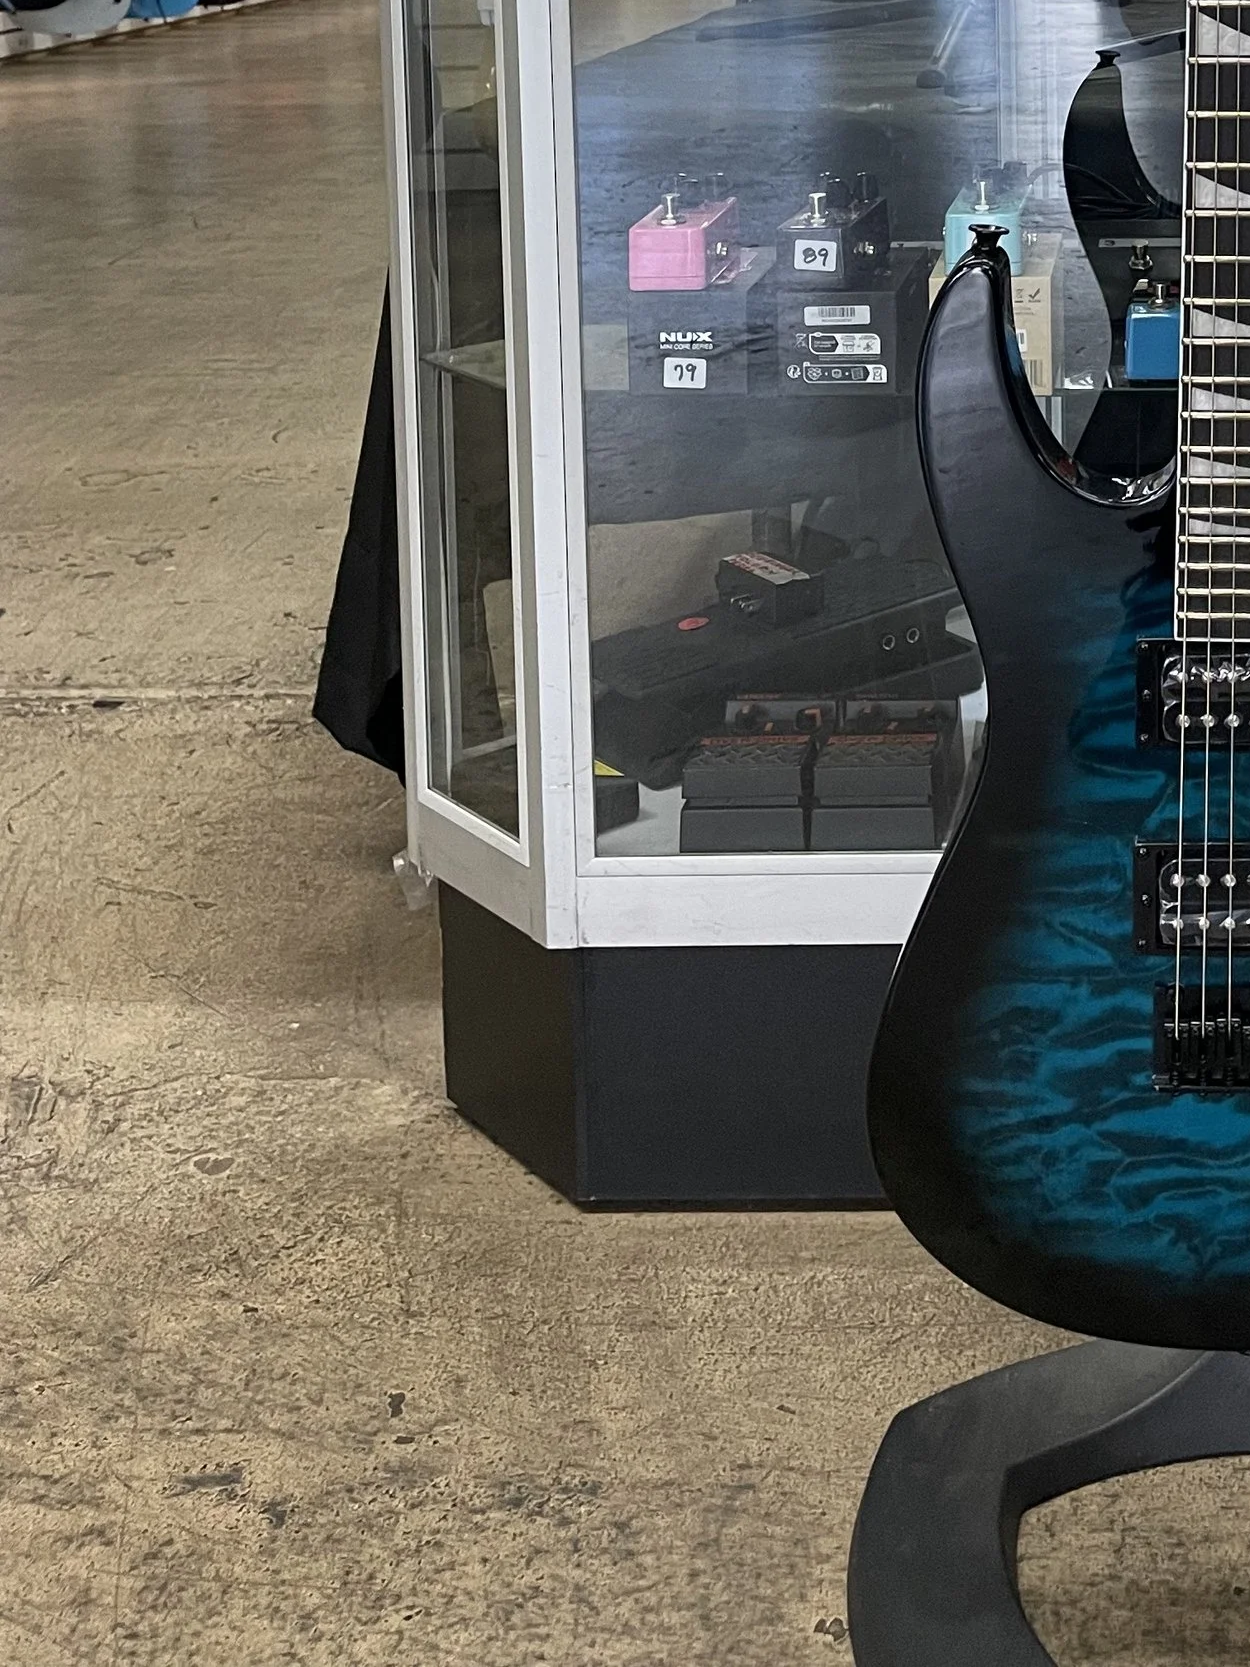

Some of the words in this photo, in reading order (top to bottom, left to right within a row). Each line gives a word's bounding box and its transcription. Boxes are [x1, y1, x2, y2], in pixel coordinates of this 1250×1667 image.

[802, 247, 829, 267] 89
[659, 331, 713, 343] NUX
[673, 364, 697, 382] 79
